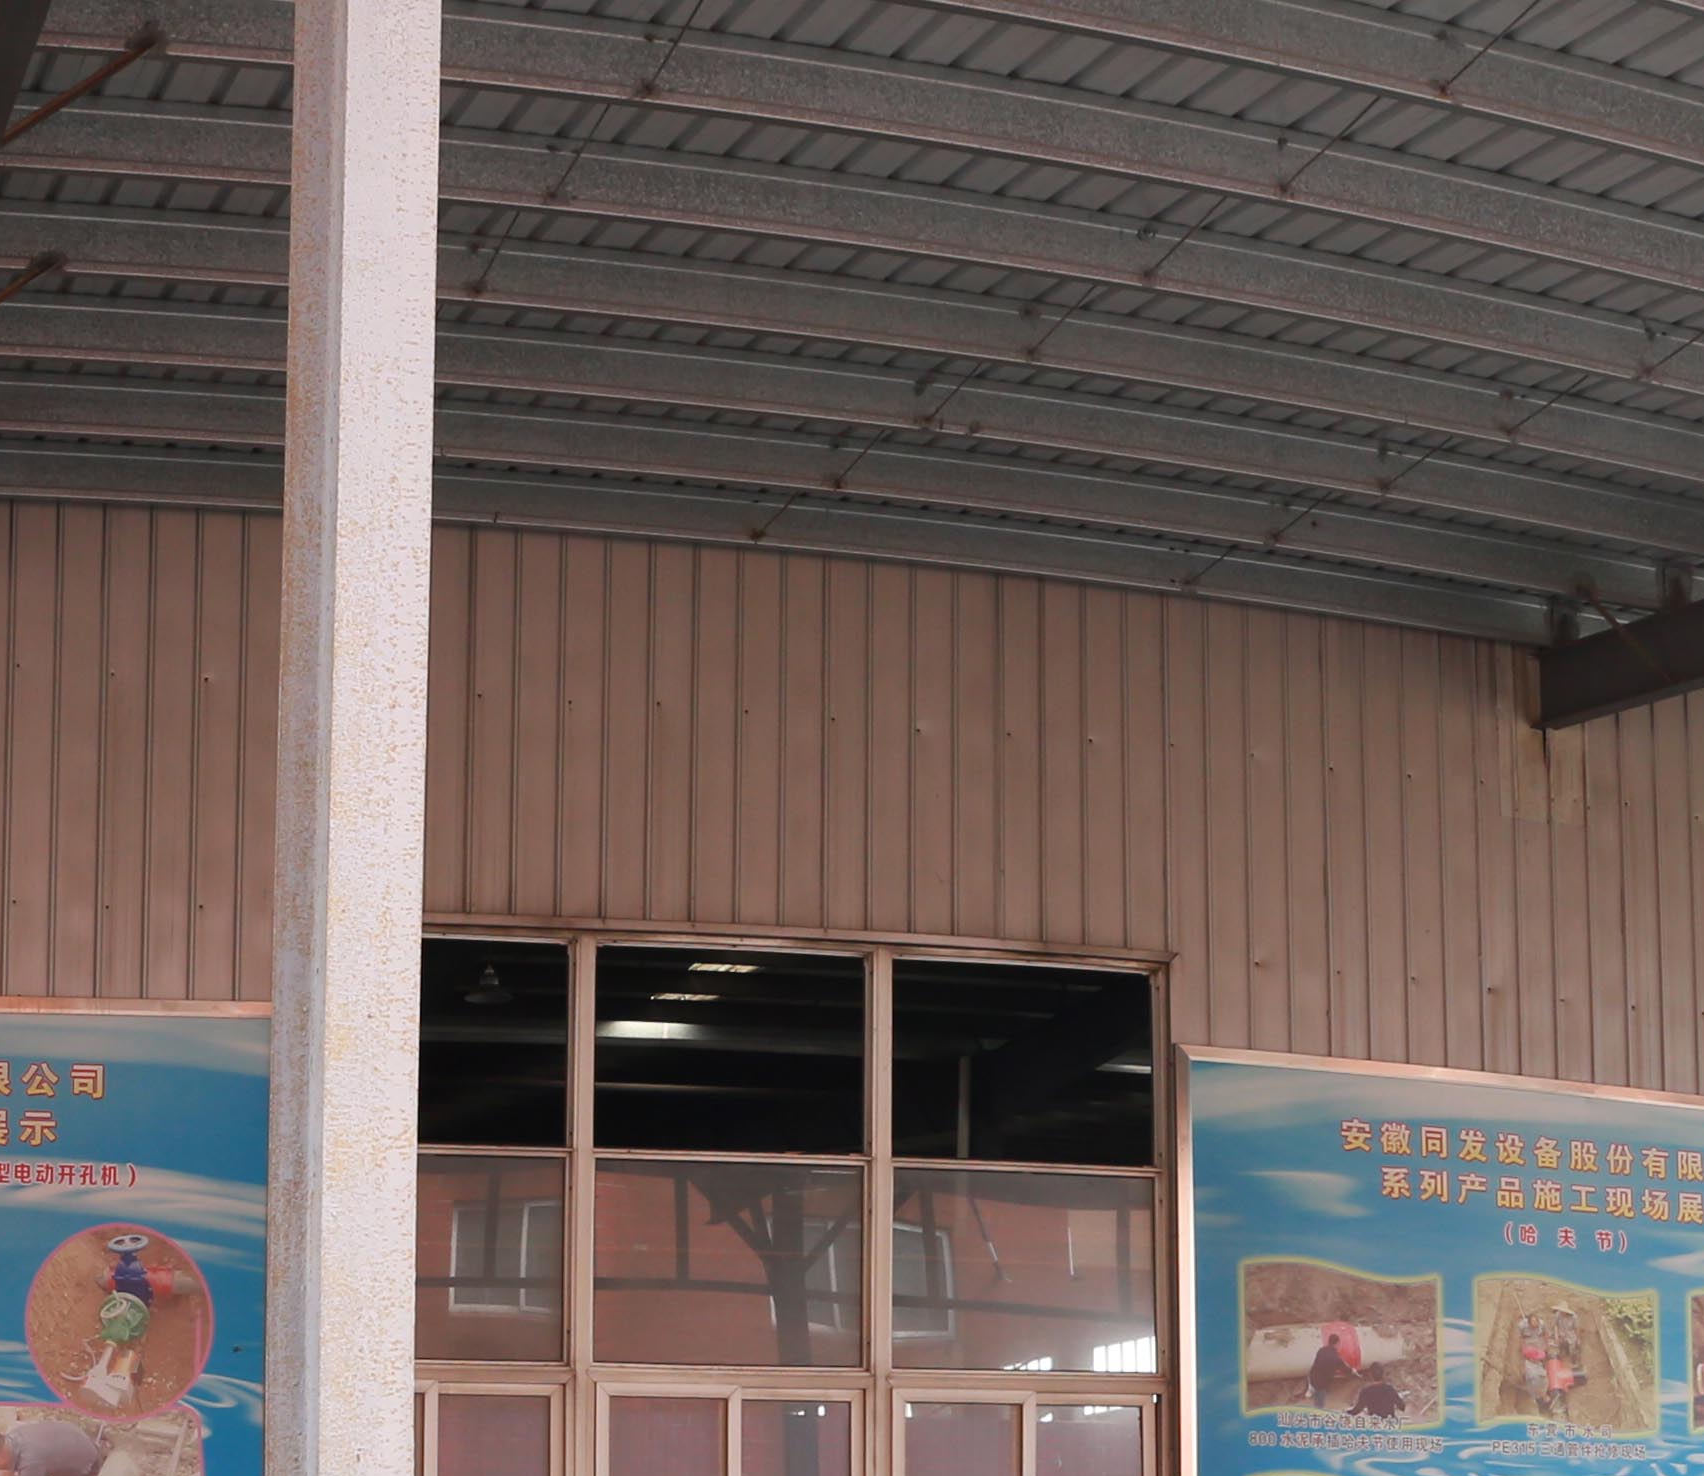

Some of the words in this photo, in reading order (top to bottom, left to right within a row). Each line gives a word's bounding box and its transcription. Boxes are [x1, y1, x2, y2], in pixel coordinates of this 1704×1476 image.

[1280, 1432, 1445, 1454] 水泥承插哈夫节使用现场
